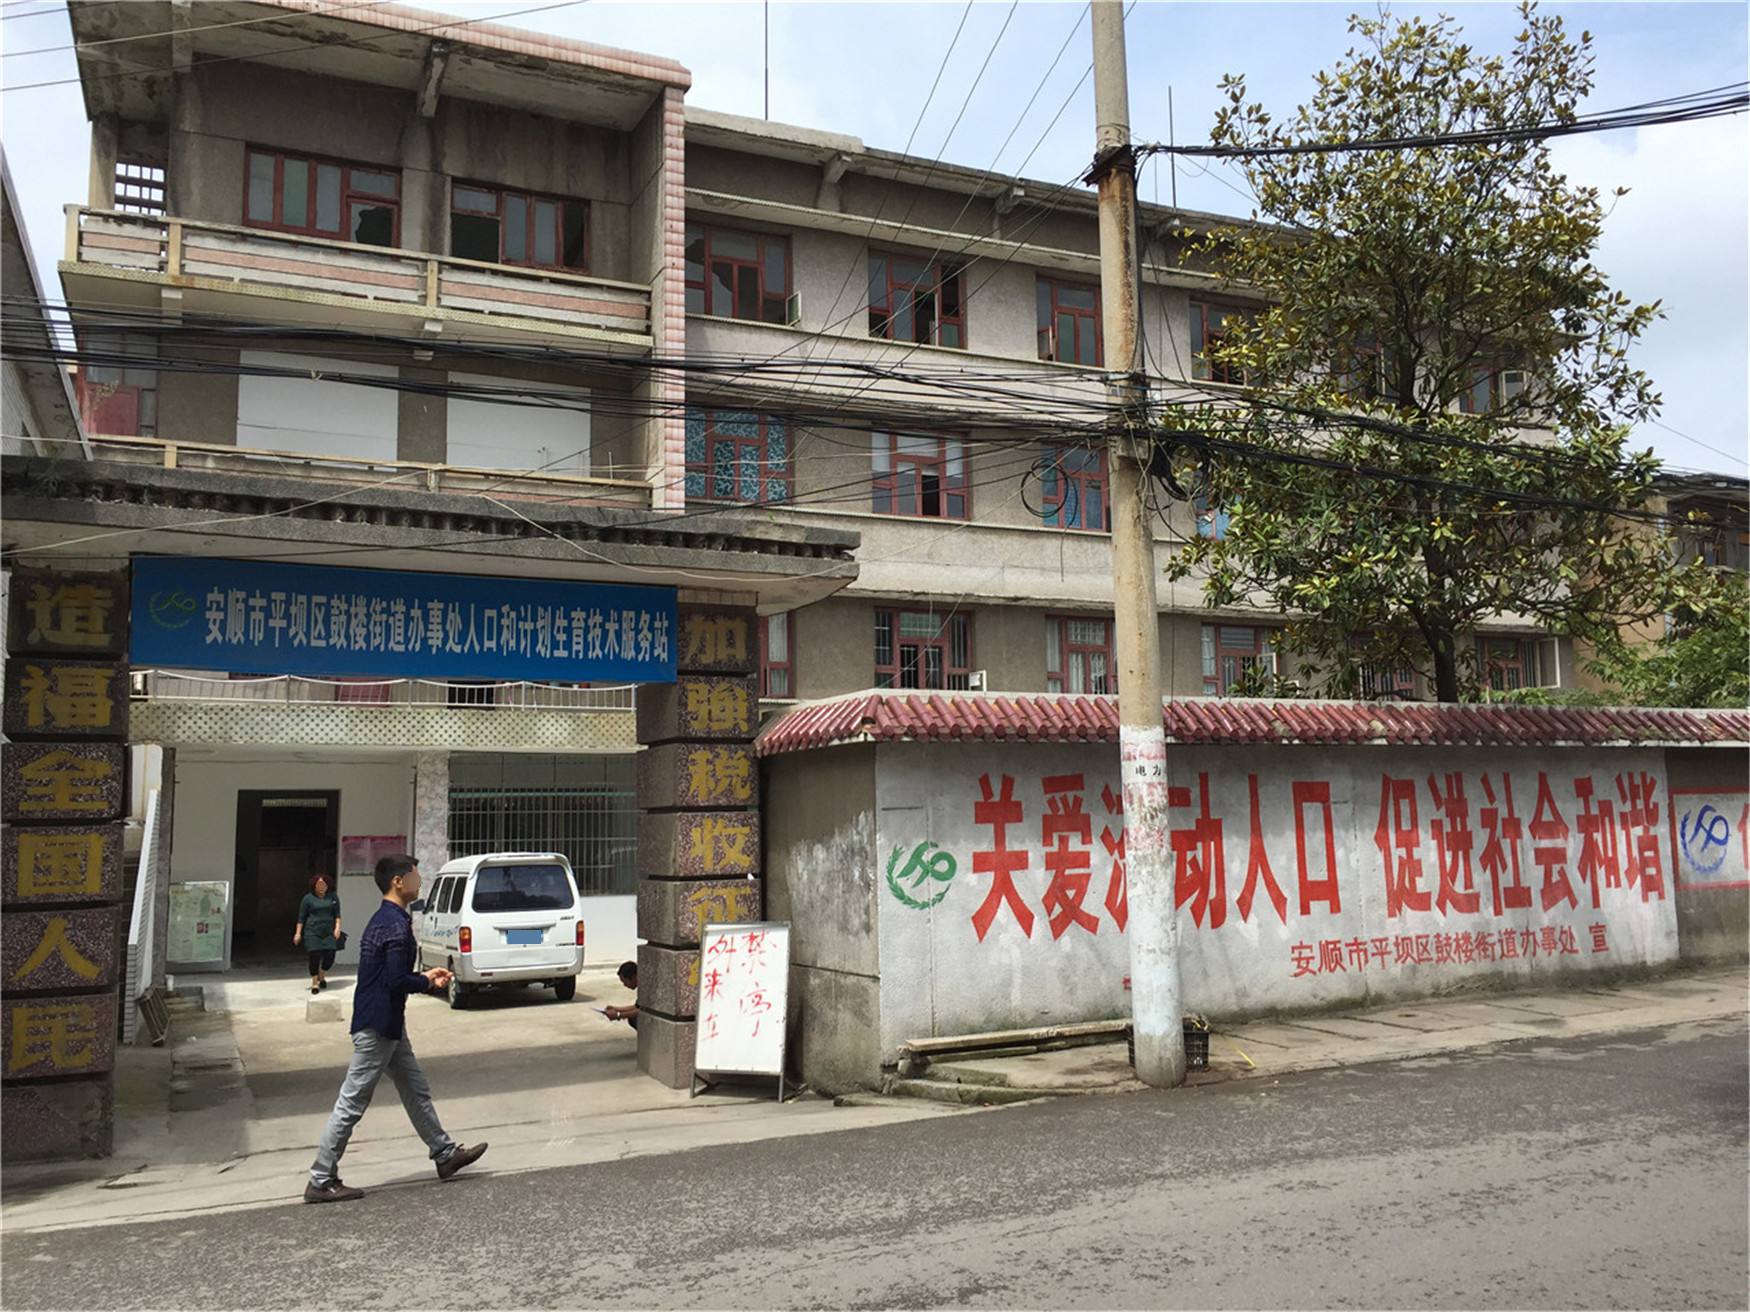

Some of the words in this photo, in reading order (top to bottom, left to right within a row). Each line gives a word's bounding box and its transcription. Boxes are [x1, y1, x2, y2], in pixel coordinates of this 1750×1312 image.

[205, 586, 669, 664] 安顺市平坝区鼓楼街道办事处人口和计划生育技术服务站
[8, 583, 115, 1072] 造福全国人民
[1374, 771, 1665, 918] 促进社会和谐
[1589, 921, 1609, 953] 宣
